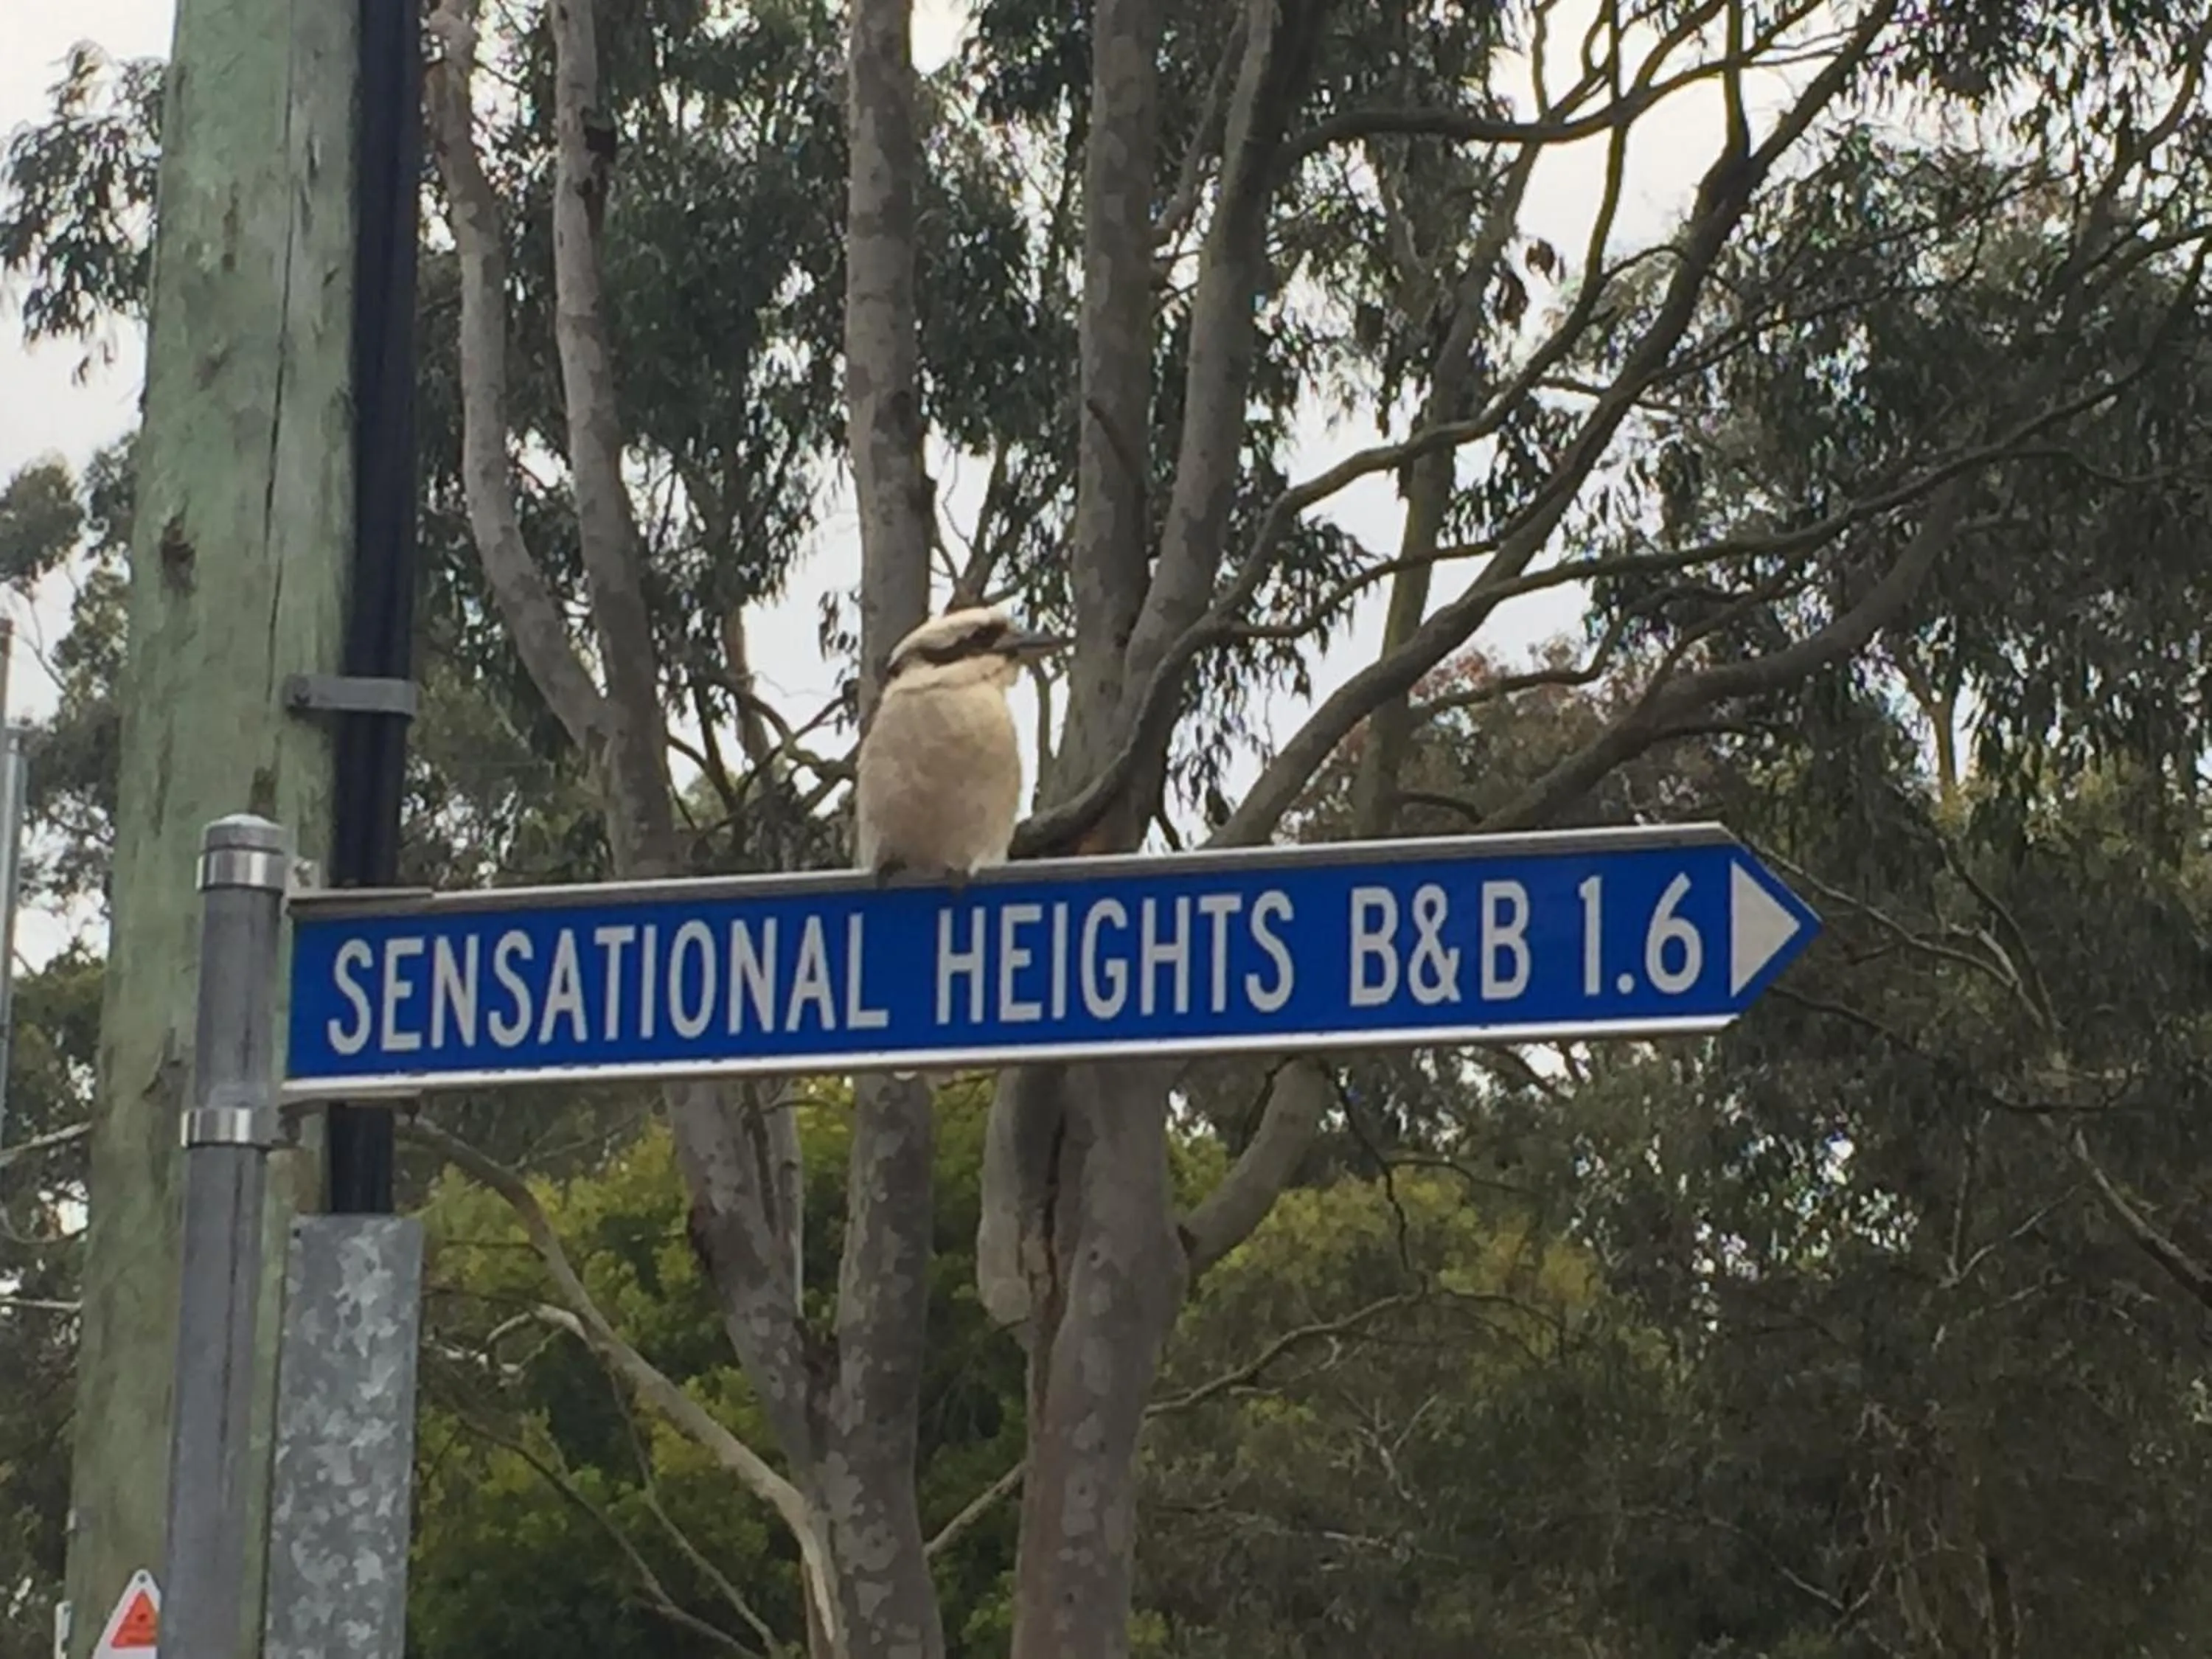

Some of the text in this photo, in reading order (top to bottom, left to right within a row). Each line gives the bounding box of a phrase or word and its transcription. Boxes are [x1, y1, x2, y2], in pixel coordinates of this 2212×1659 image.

[327, 872, 1703, 1055] SENSATIONAL HEIGHTS B&B 1.6
